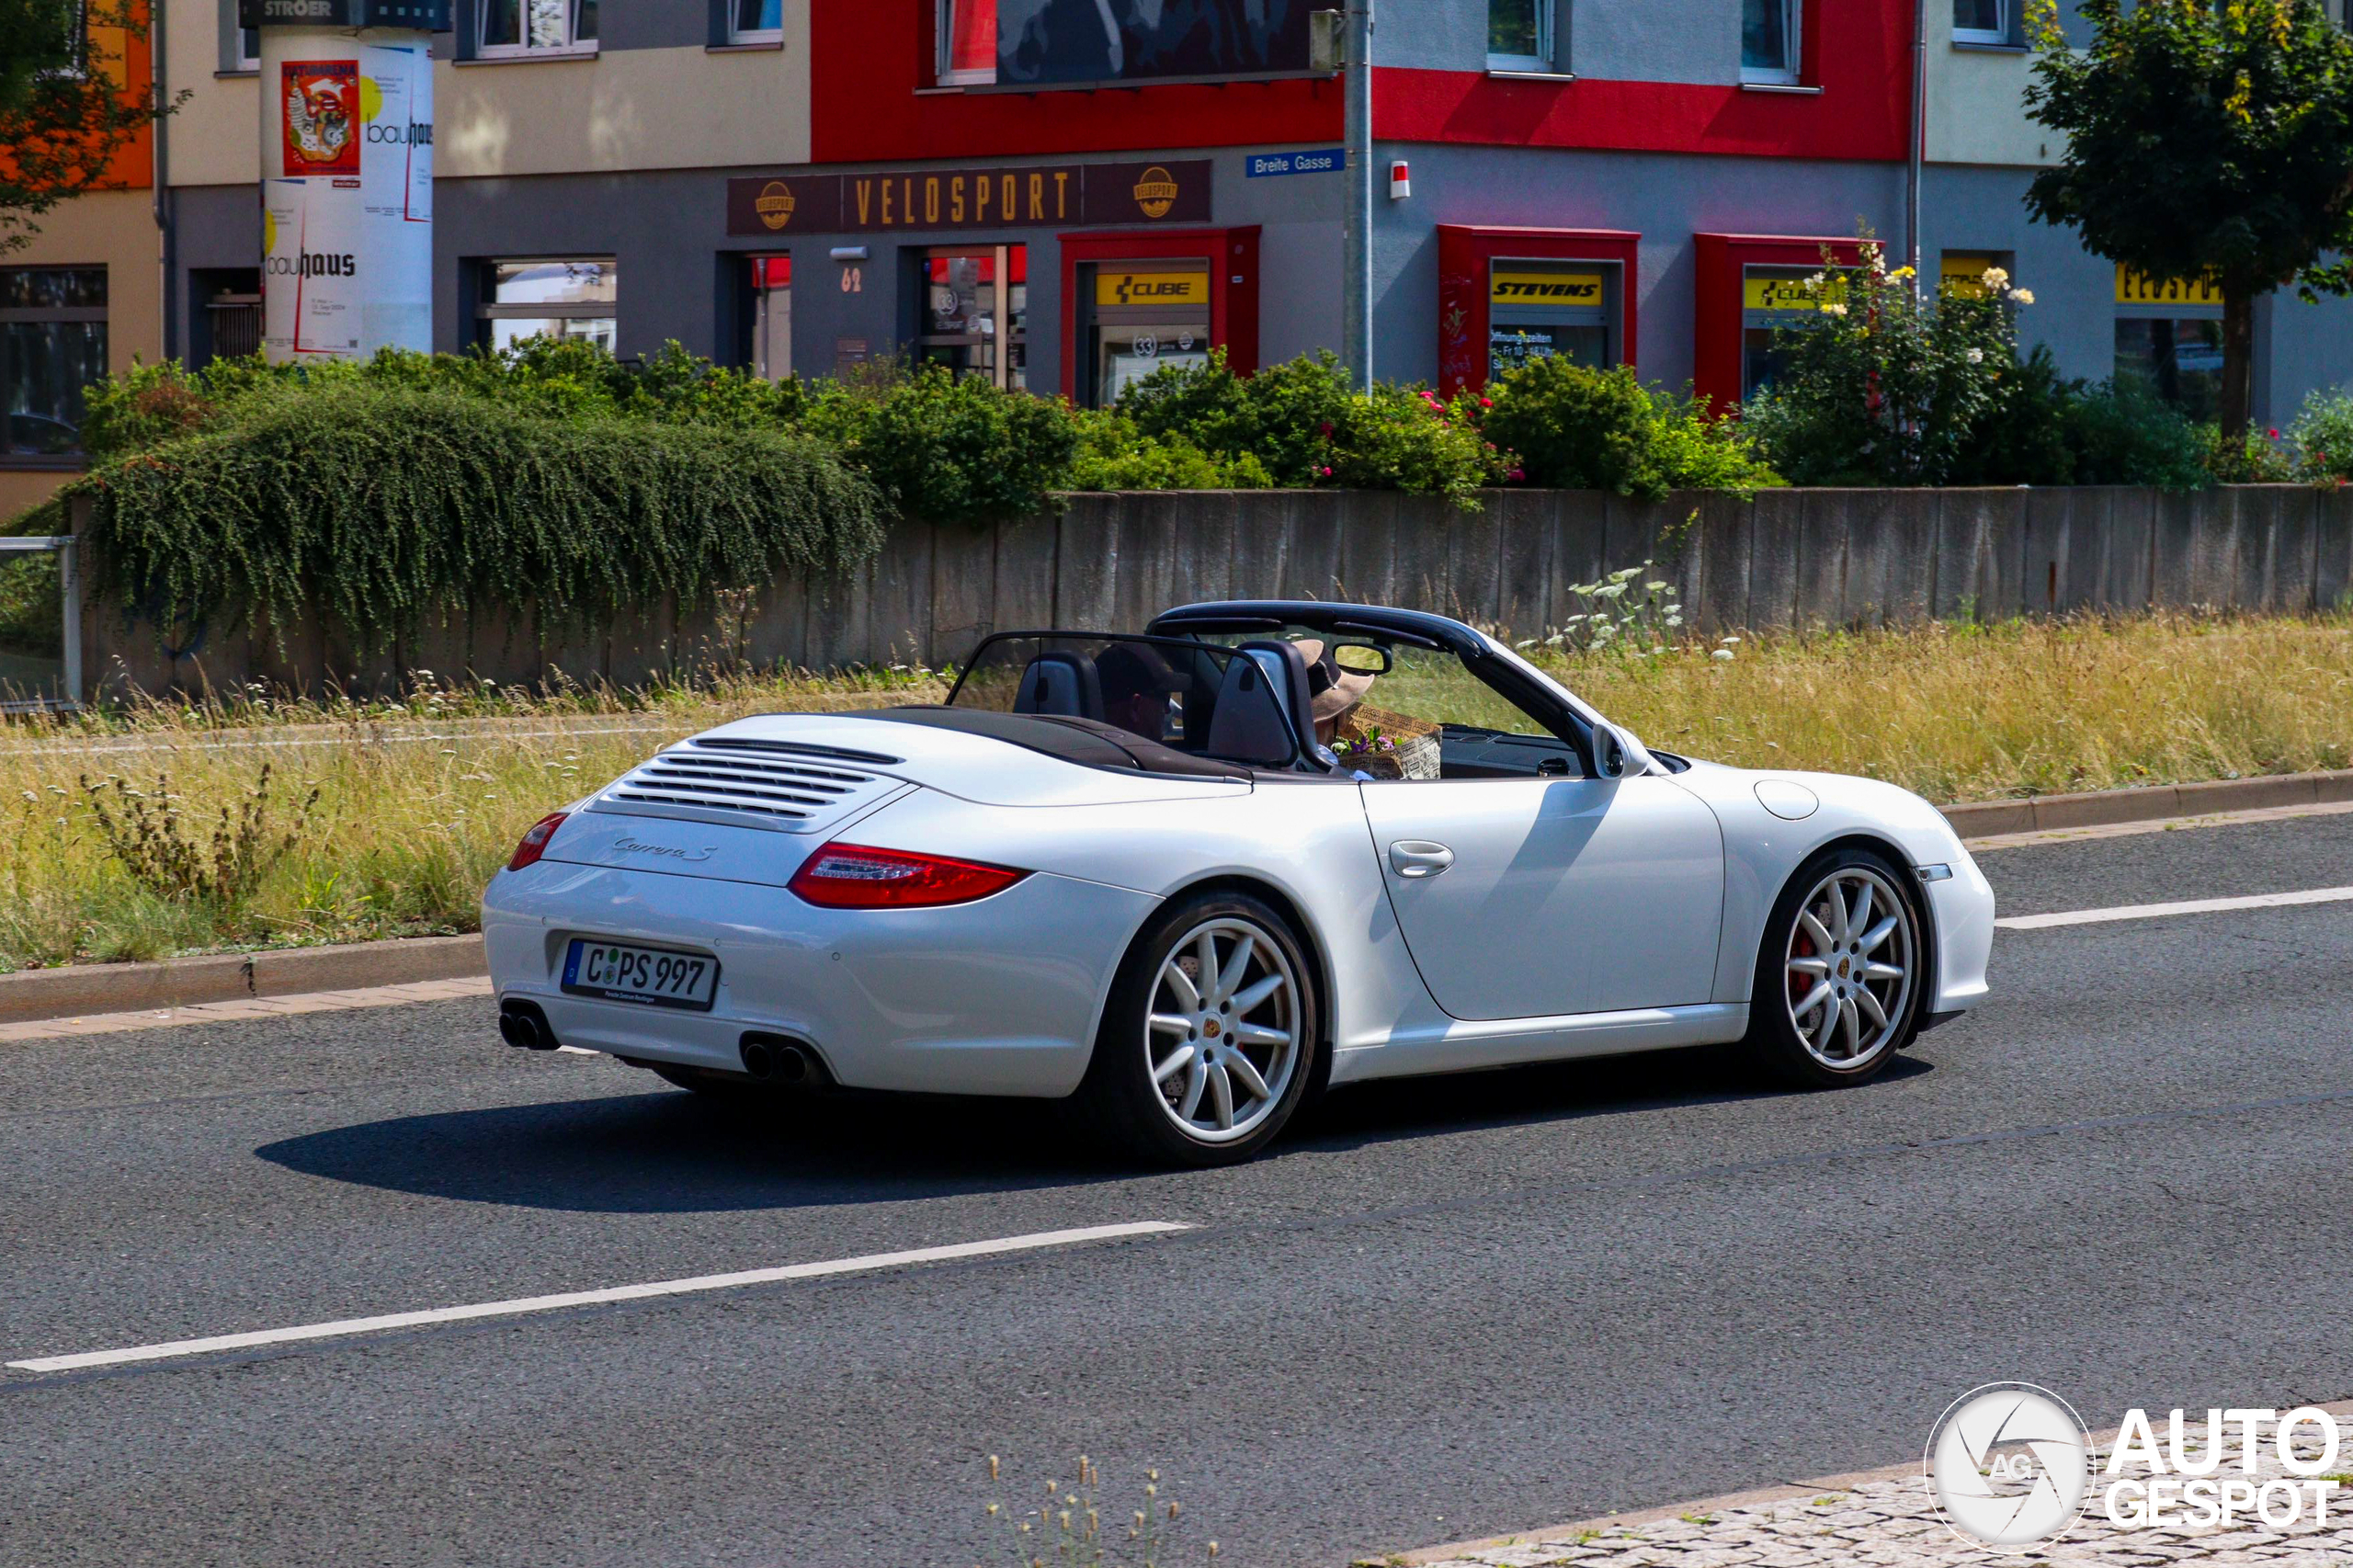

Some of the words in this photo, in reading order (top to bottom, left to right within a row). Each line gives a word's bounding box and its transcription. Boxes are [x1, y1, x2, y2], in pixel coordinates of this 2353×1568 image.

[1255, 156, 1289, 174] Breite
[1295, 155, 1332, 170] Gasse
[856, 172, 1068, 225] VELOSPORT
[841, 267, 861, 292] 62
[1132, 282, 1190, 296] CUBE
[1494, 282, 1598, 297] STEVENS
[1777, 288, 1826, 301] CUBE
[1137, 337, 1154, 355] 33
[613, 837, 686, 858] Carrera
[682, 846, 718, 862] S
[587, 949, 604, 982] C
[617, 950, 652, 989] PS
[654, 957, 705, 995] 997
